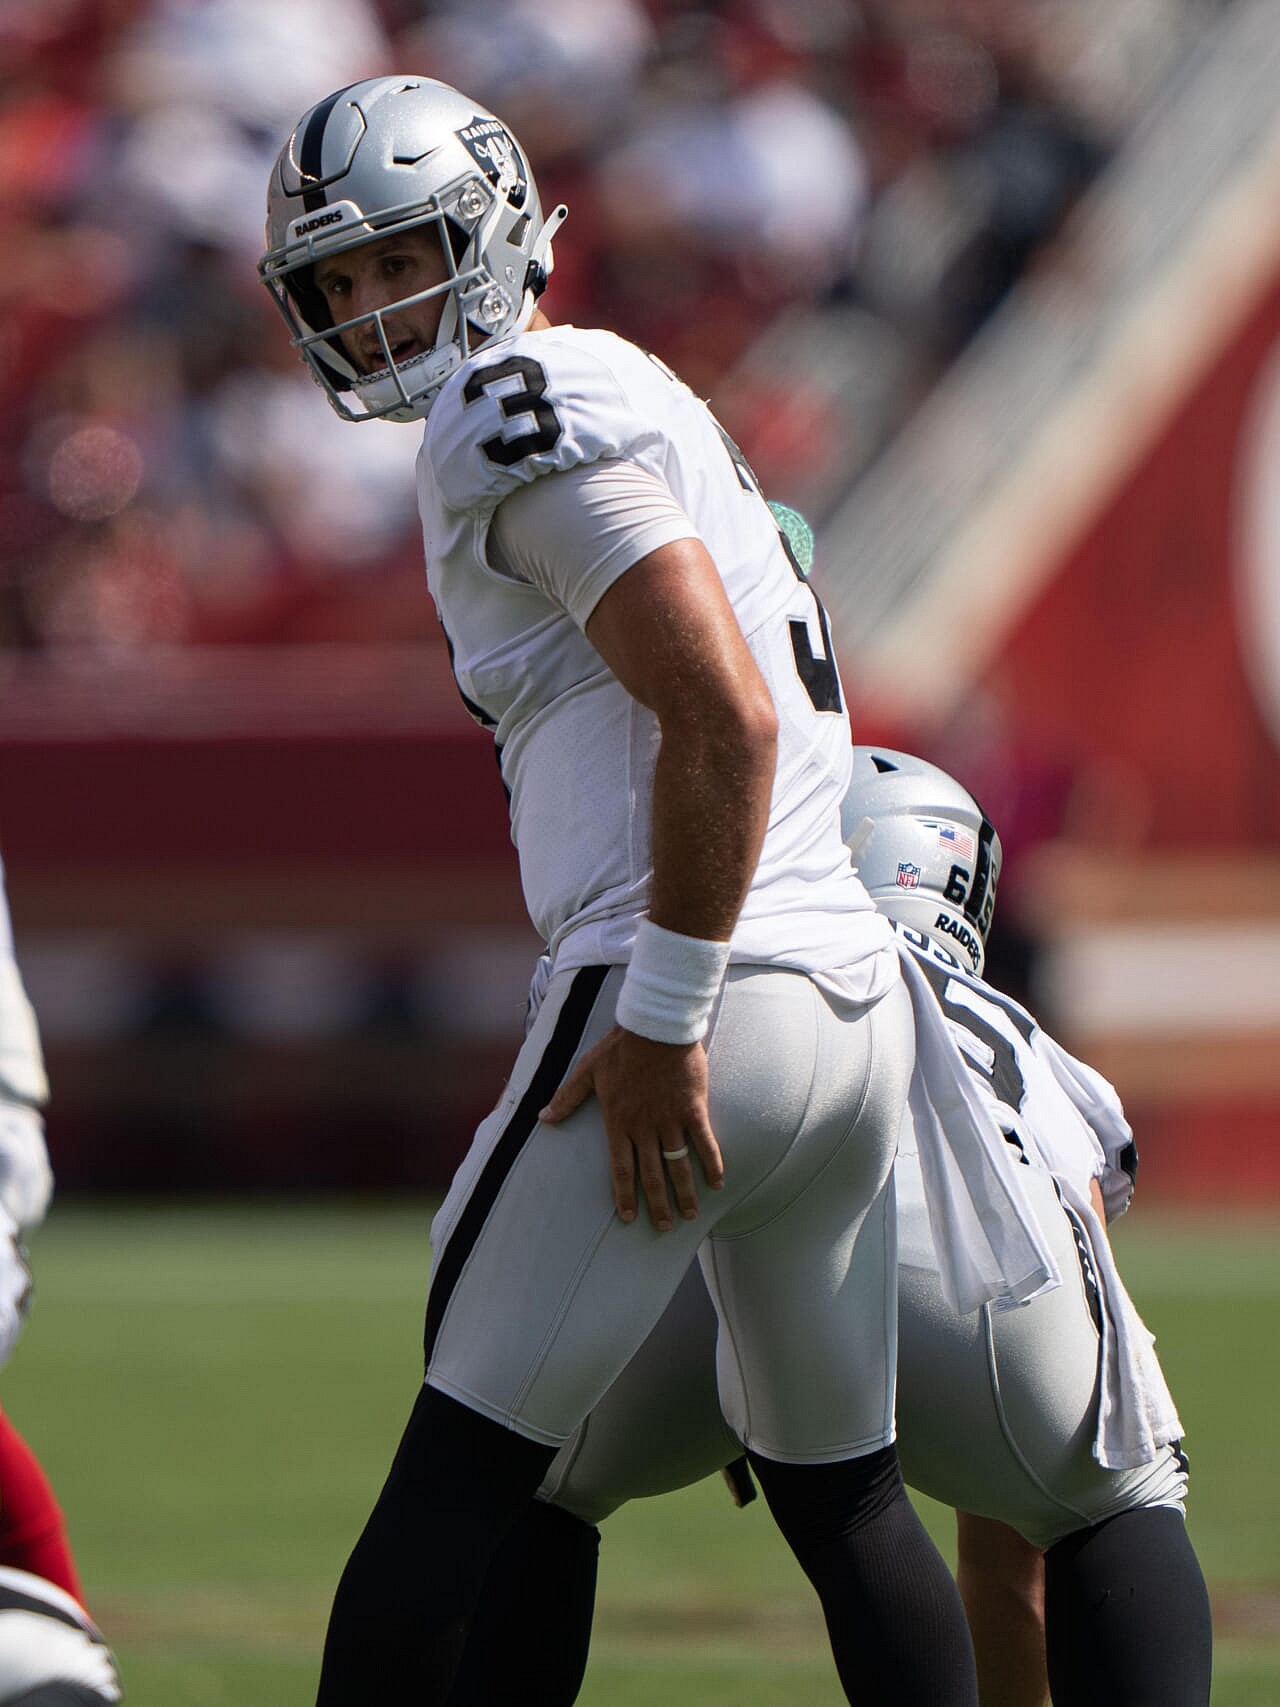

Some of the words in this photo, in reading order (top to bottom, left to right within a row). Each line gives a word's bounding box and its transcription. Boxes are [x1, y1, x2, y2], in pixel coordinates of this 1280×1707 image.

[294, 209, 343, 238] RAIDERS
[463, 355, 562, 467] 3
[943, 863, 970, 906] 6
